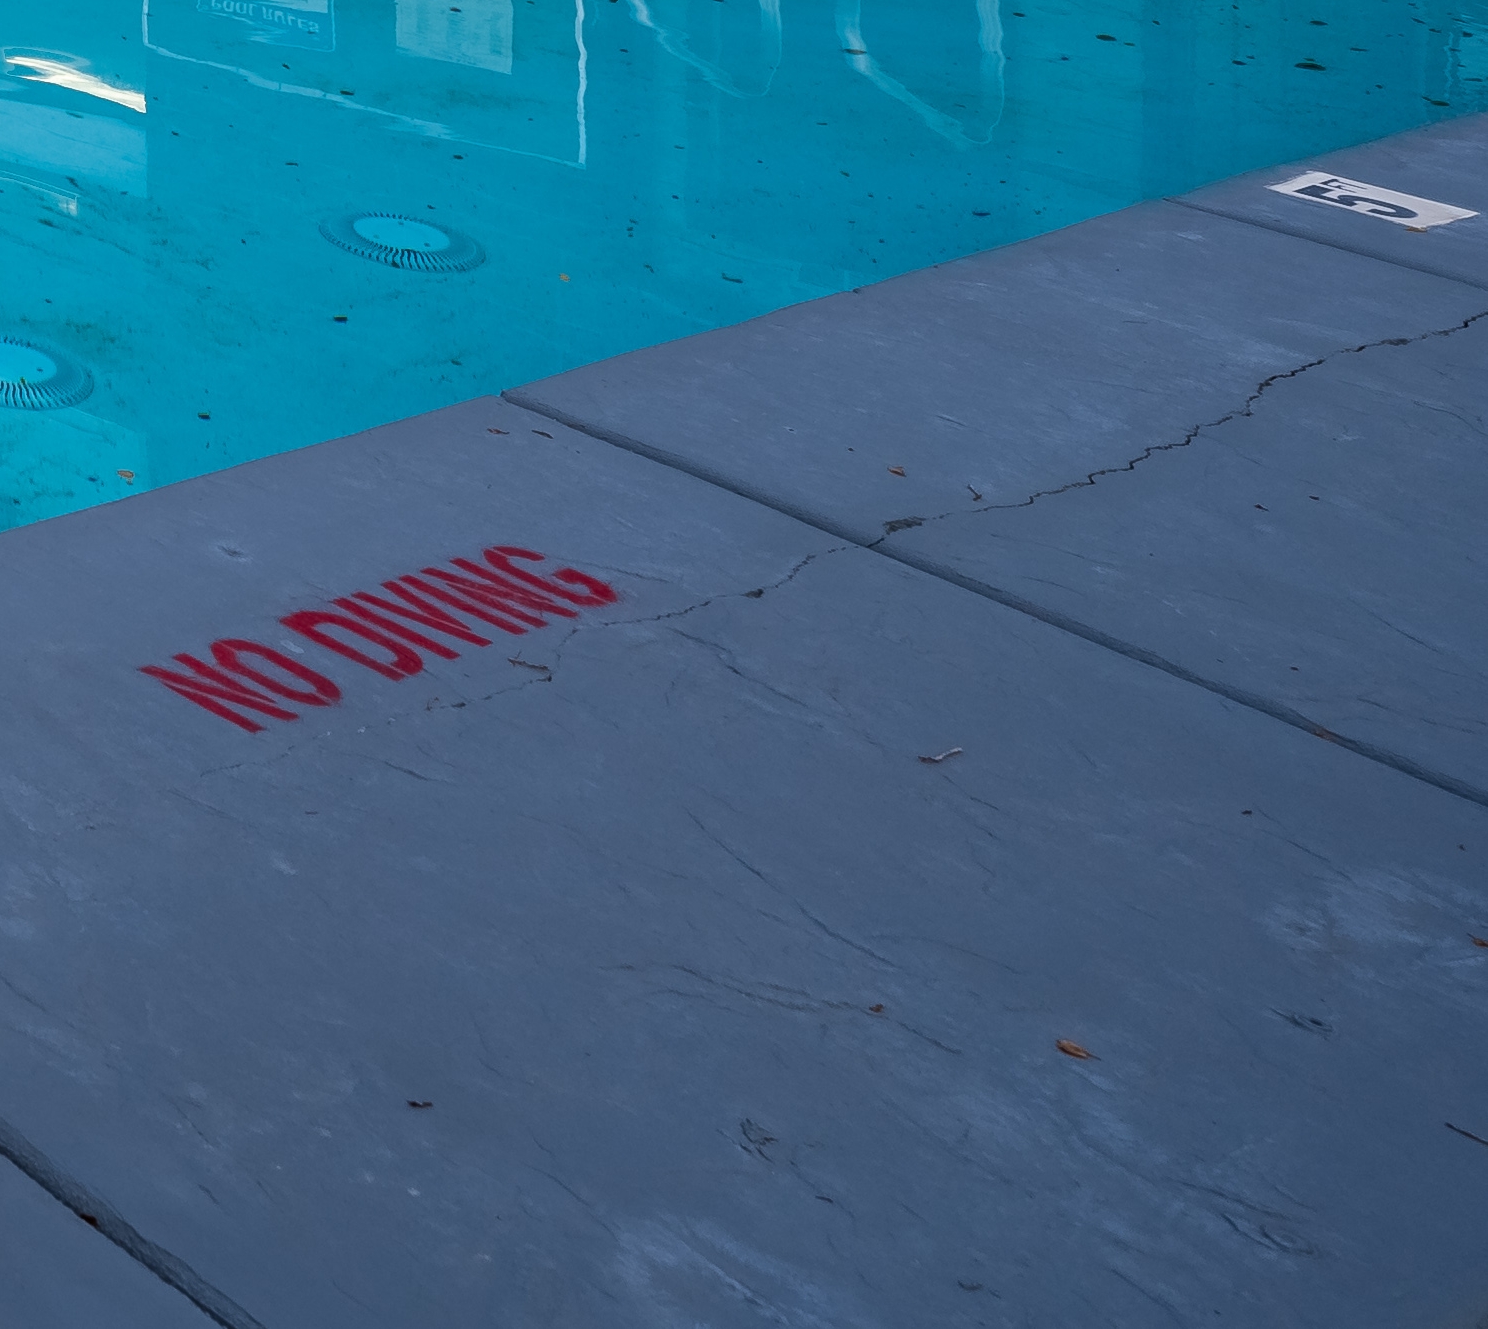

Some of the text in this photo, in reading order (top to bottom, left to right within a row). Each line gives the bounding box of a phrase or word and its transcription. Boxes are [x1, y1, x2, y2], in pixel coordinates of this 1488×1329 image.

[1293, 184, 1419, 219] 5
[139, 545, 618, 734] NO DIVING
